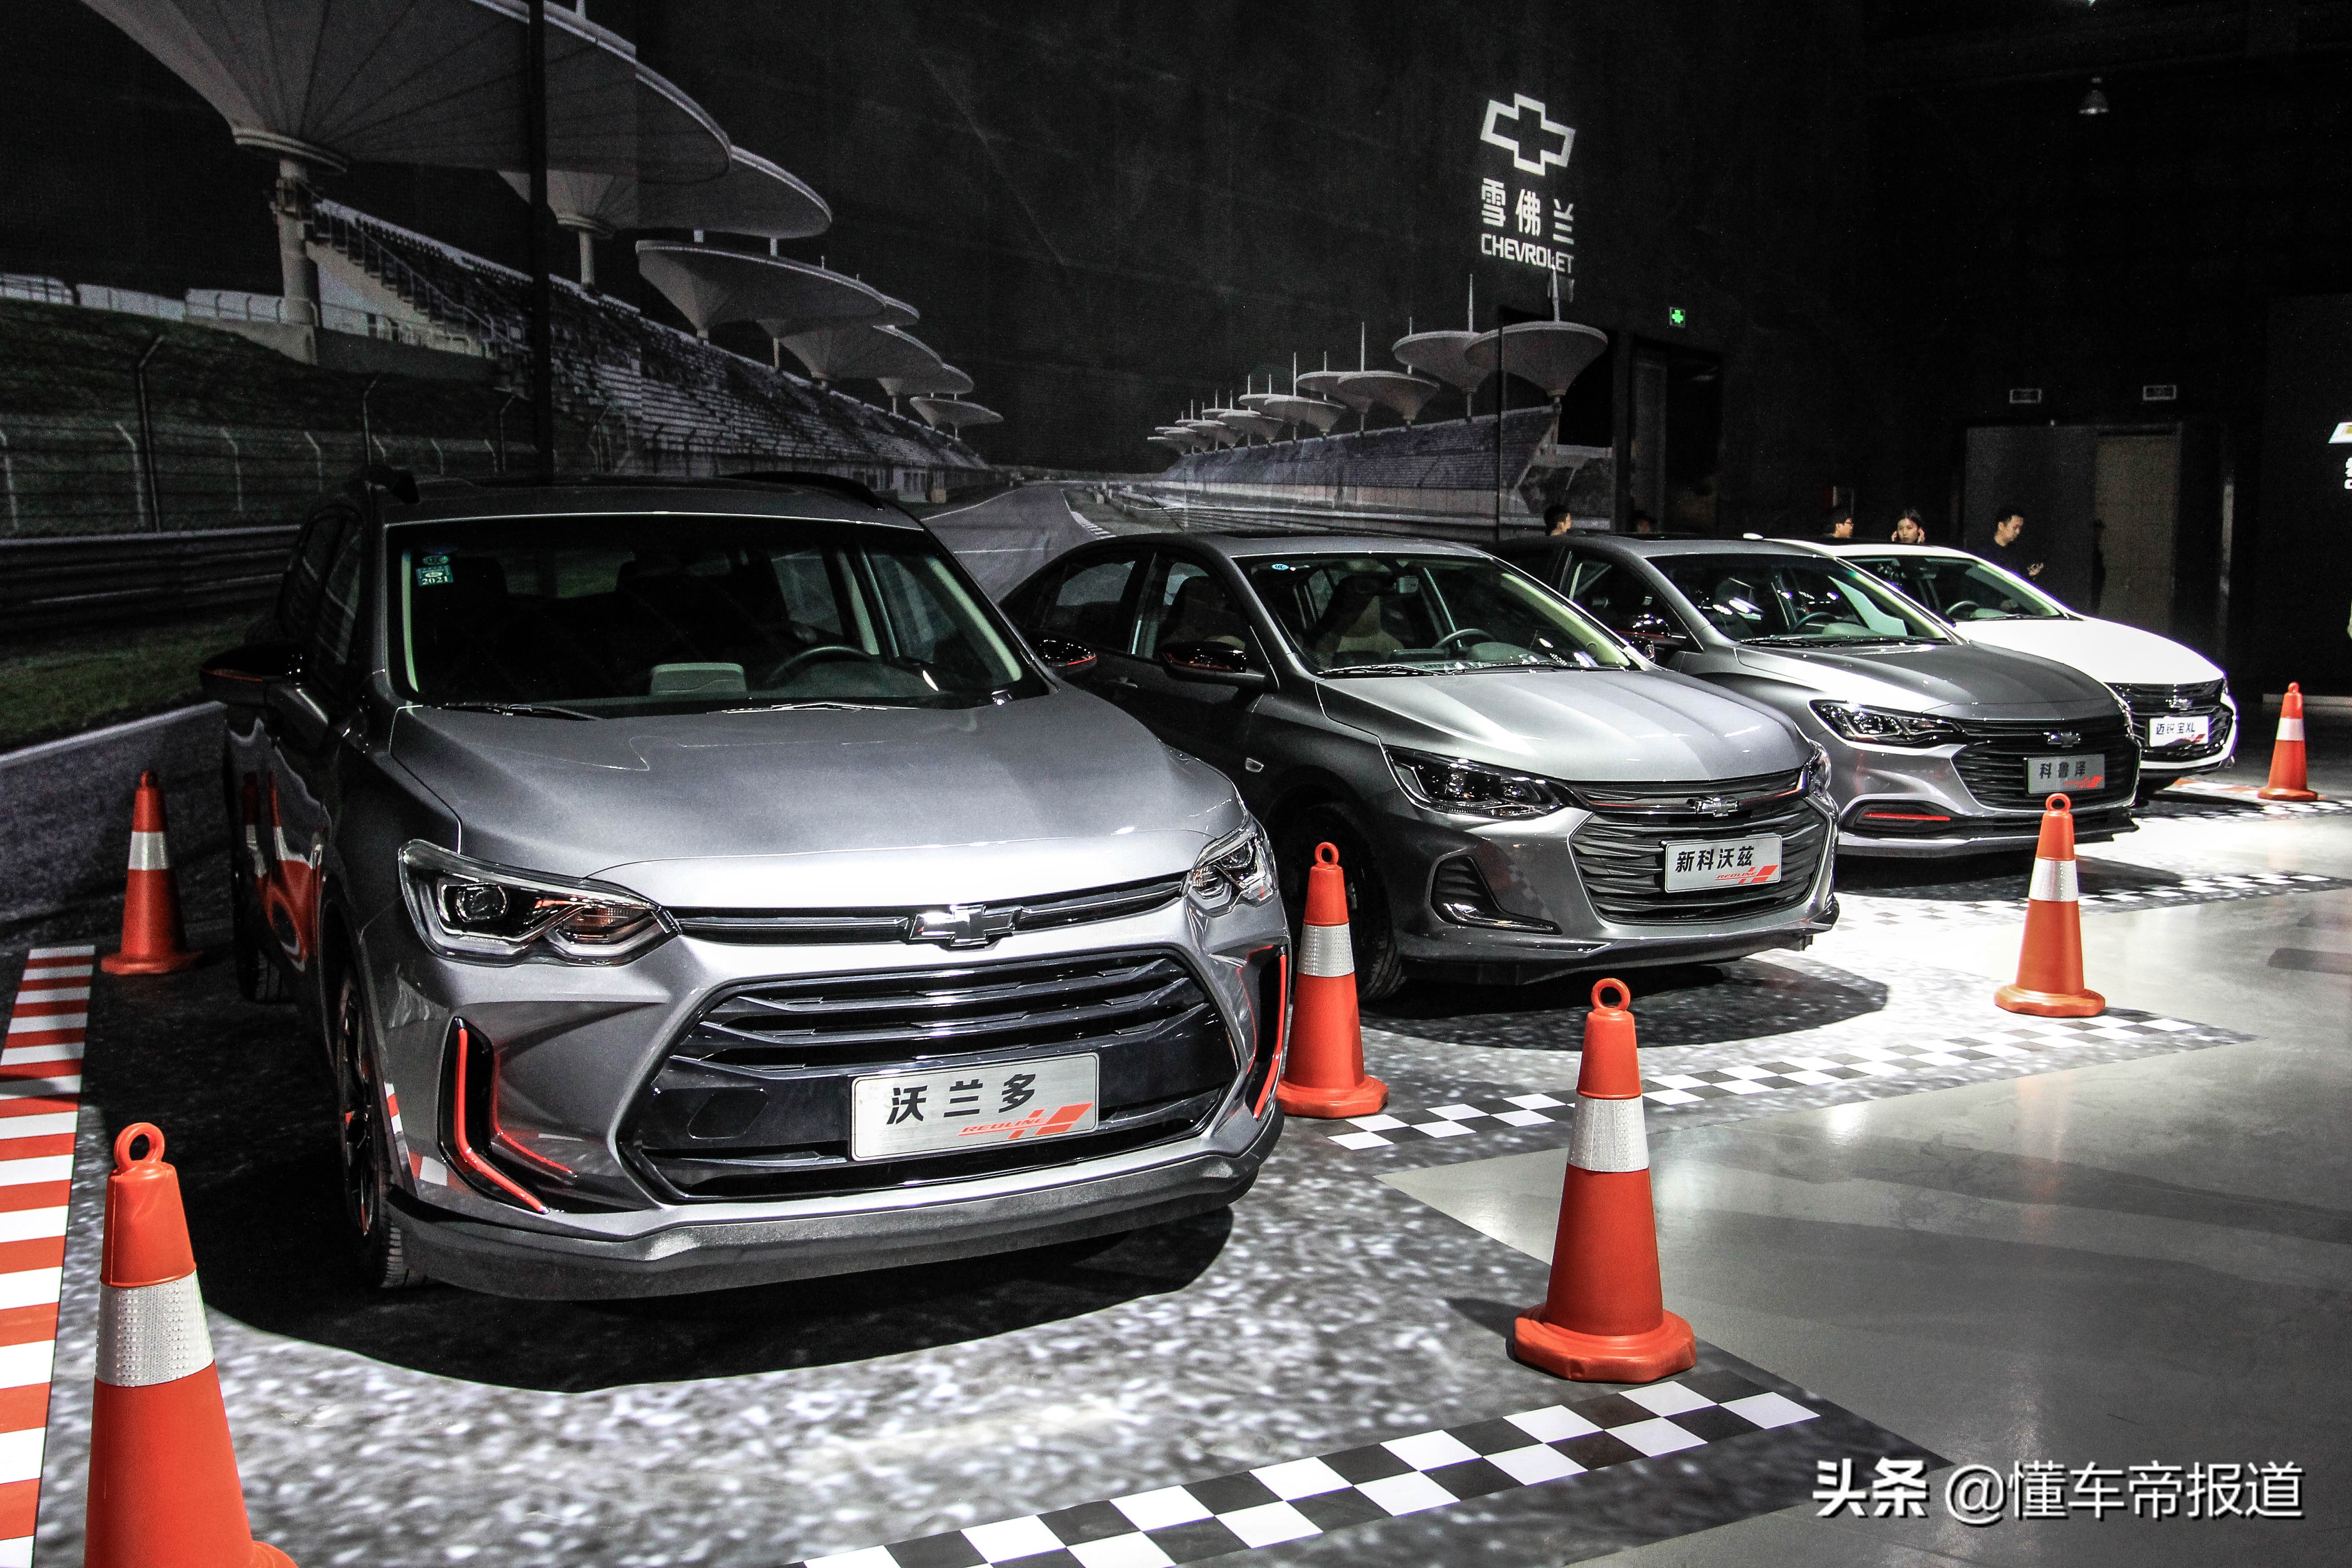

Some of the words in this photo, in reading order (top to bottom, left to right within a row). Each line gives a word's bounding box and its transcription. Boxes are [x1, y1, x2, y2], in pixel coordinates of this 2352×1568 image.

[1481, 178, 1574, 245] 雪佛兰
[1481, 233, 1574, 274] CHEVROLET
[421, 576, 448, 585] 2021
[2039, 761, 2086, 779] 科鲁泽
[1675, 845, 1754, 873] 新科沃兹
[887, 1073, 1036, 1125] 沃兰多
[961, 1117, 1048, 1133] REDLINE
